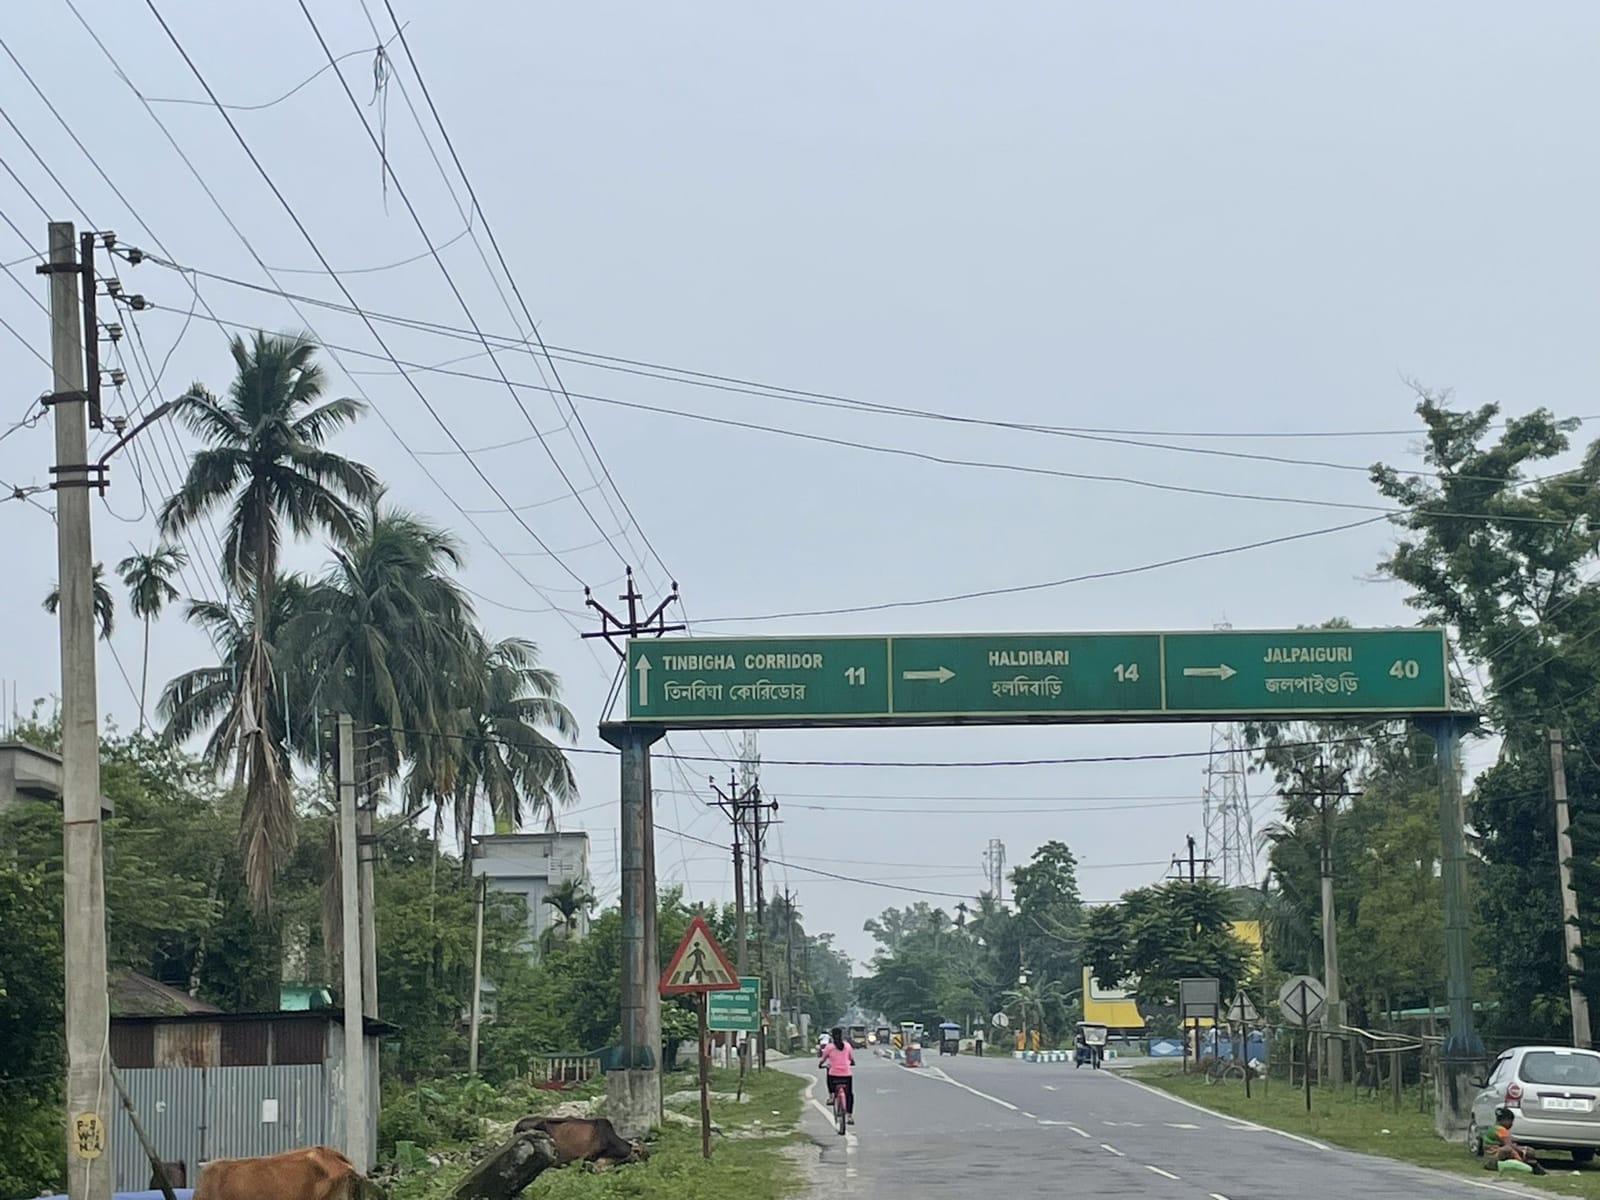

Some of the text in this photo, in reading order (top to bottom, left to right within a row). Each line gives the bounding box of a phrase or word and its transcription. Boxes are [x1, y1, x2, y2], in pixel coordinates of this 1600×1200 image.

[662, 653, 823, 671] TINBIGHA CORRIDOR
[988, 650, 1070, 666] HALDIBARI
[1264, 646, 1353, 663] JALPAIGURI
[844, 666, 866, 685] 11
[1113, 663, 1139, 682] 14
[1389, 660, 1419, 679] 40
[664, 679, 806, 701] তিনবিঘা কোরিডোর
[991, 675, 1063, 698] হলদিবাড়ি
[1264, 672, 1360, 695] জলপাইগুড়ি
